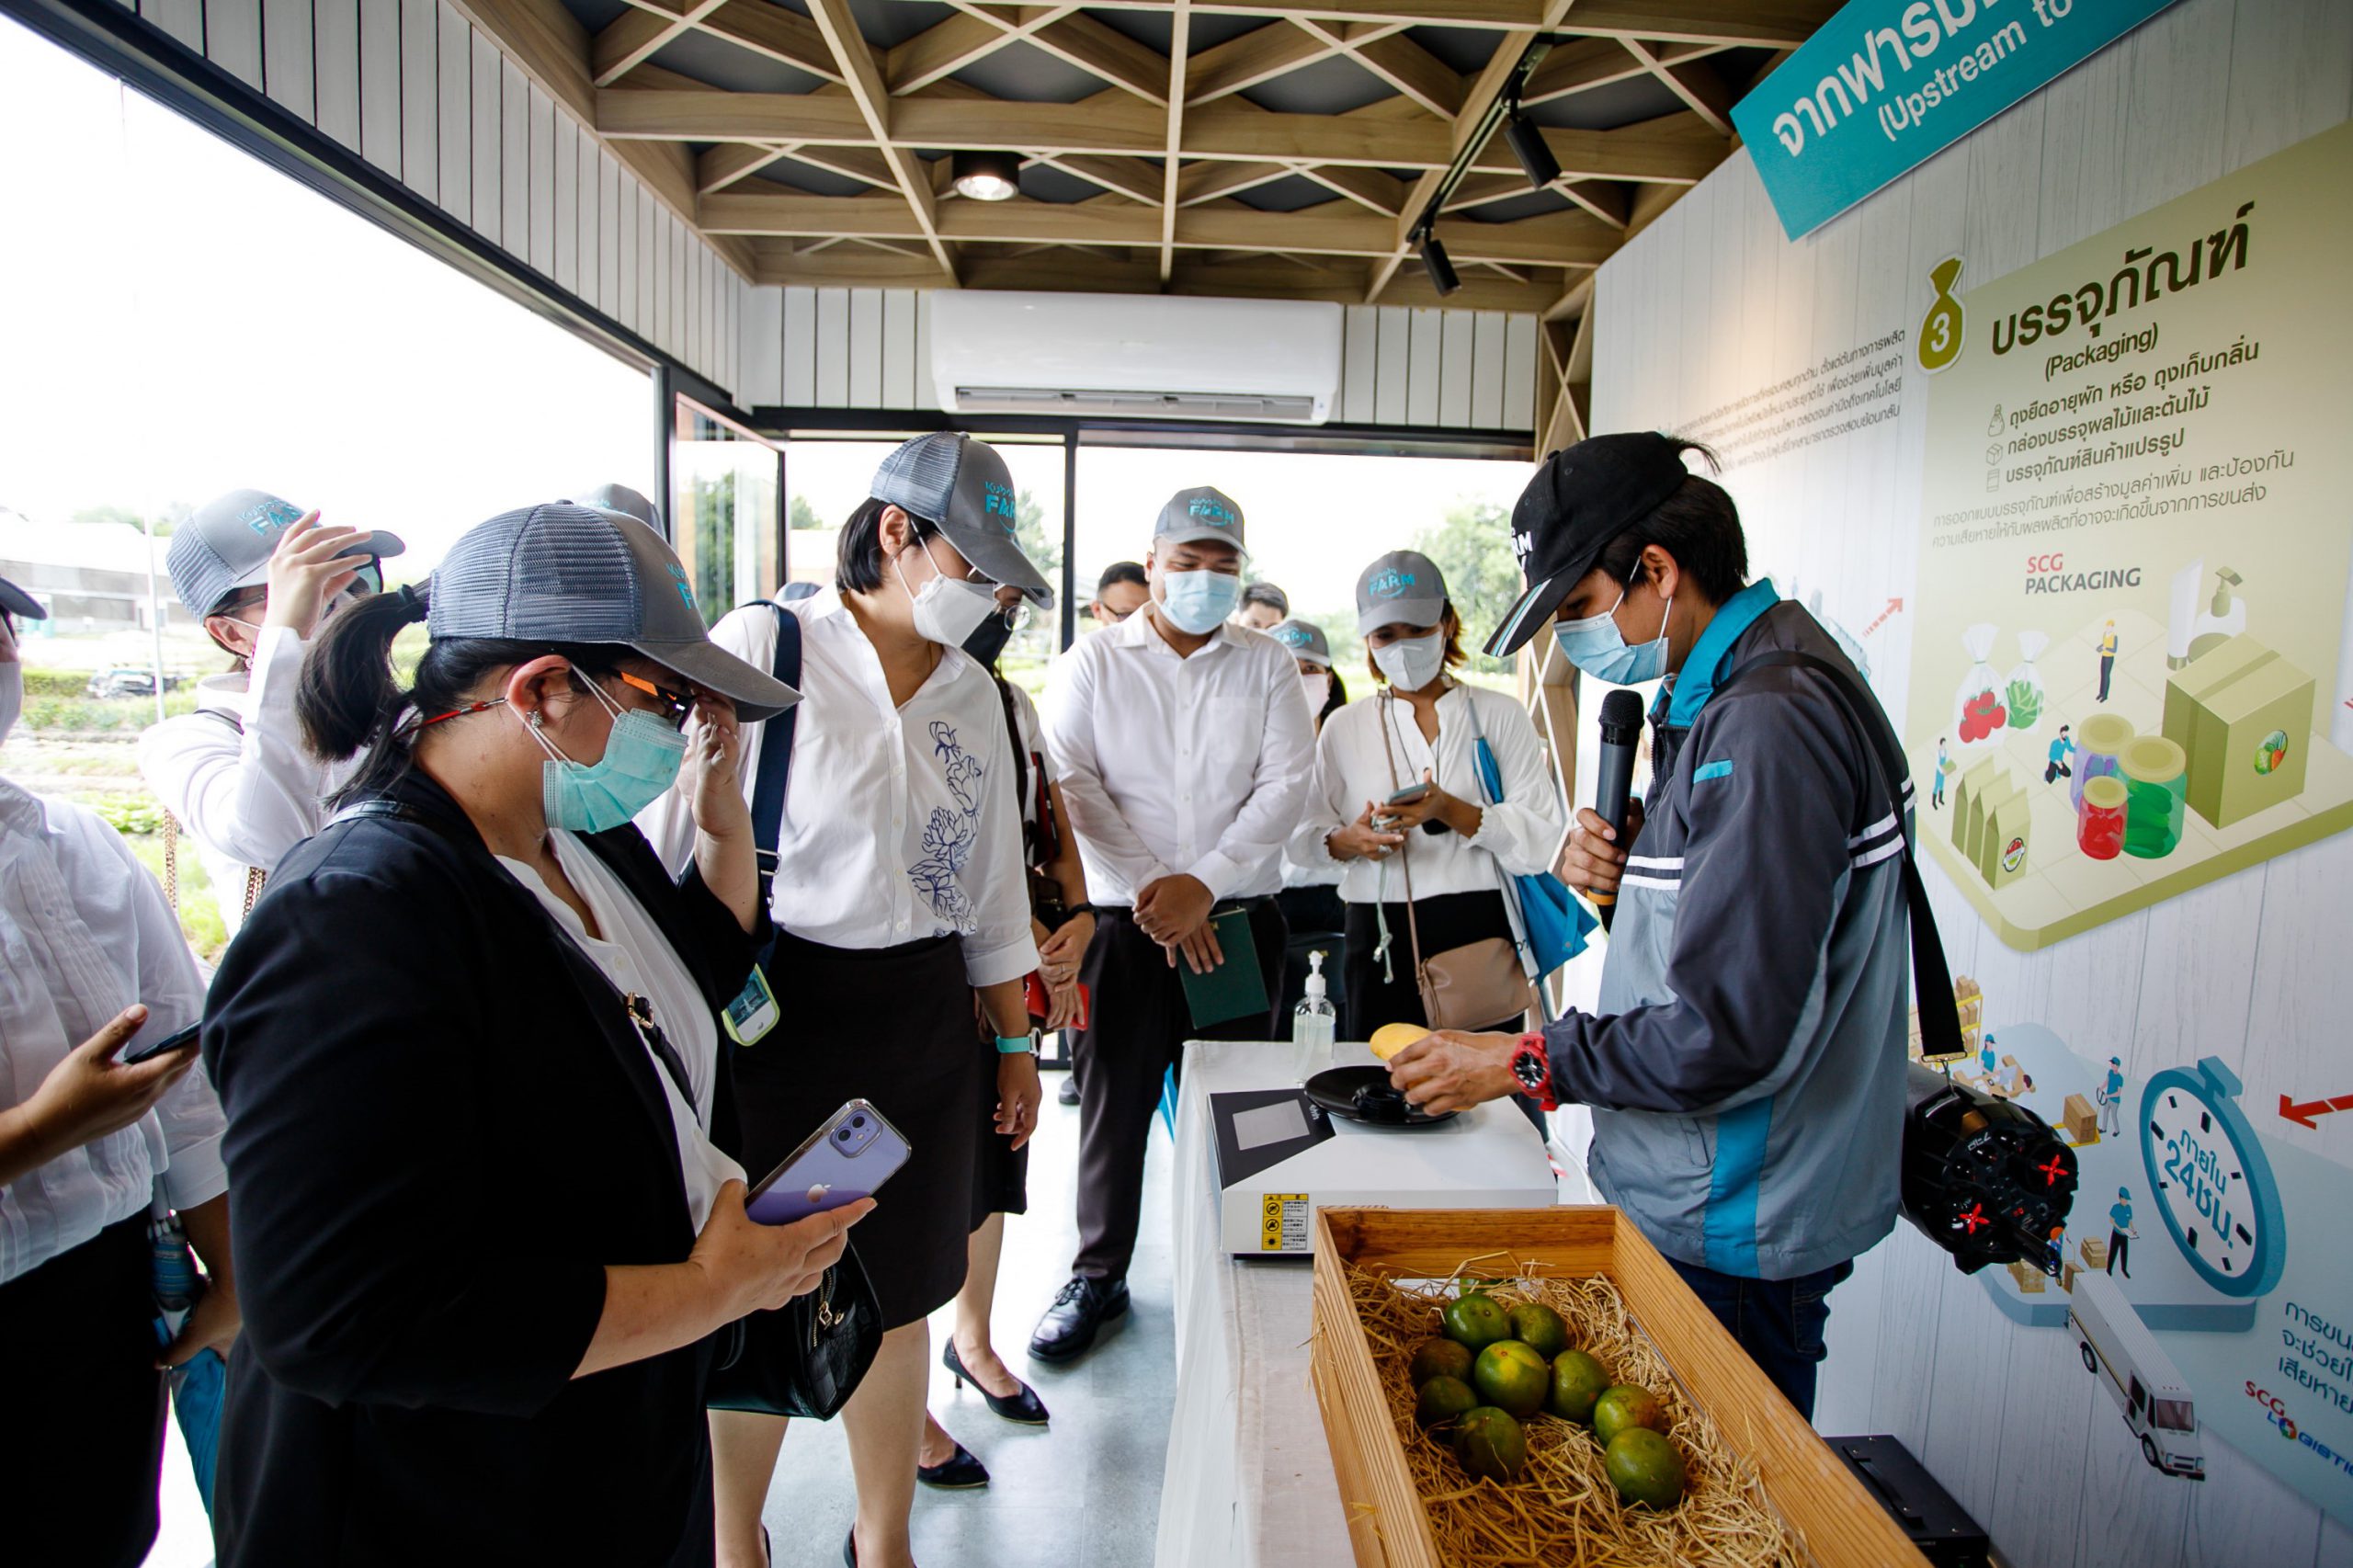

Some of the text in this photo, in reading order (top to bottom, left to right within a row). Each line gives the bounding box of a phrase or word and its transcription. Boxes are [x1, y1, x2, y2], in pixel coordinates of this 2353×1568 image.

[1878, 20, 2028, 142] (Upstream
[1992, 199, 2255, 355] บรรจุภัณฑ์
[1930, 312, 1950, 353] 3
[2045, 322, 2159, 381] (Packaging)
[2010, 335, 2259, 429] ถุงยืดอายุผัก หรือ ถุงเก็บกลิ่น
[2007, 385, 2211, 454] กล่องบรรจุผลไม้และต้นไม้
[2006, 427, 2185, 483] บรรจุภัณฑ์สินค้าแปรรูป
[1189, 505, 1235, 525] FARM
[1933, 449, 2294, 528] การออกแบบบรรจุภัณฑ์เพื่อสร้างมูลค่าเพิ่ม และป้องกัน
[1369, 574, 1415, 597] FARM
[2024, 567, 2142, 596] PACKAGING
[2026, 552, 2064, 574] SCG
[2285, 1301, 2353, 1352] การขน
[2245, 1381, 2285, 1416] SCG
